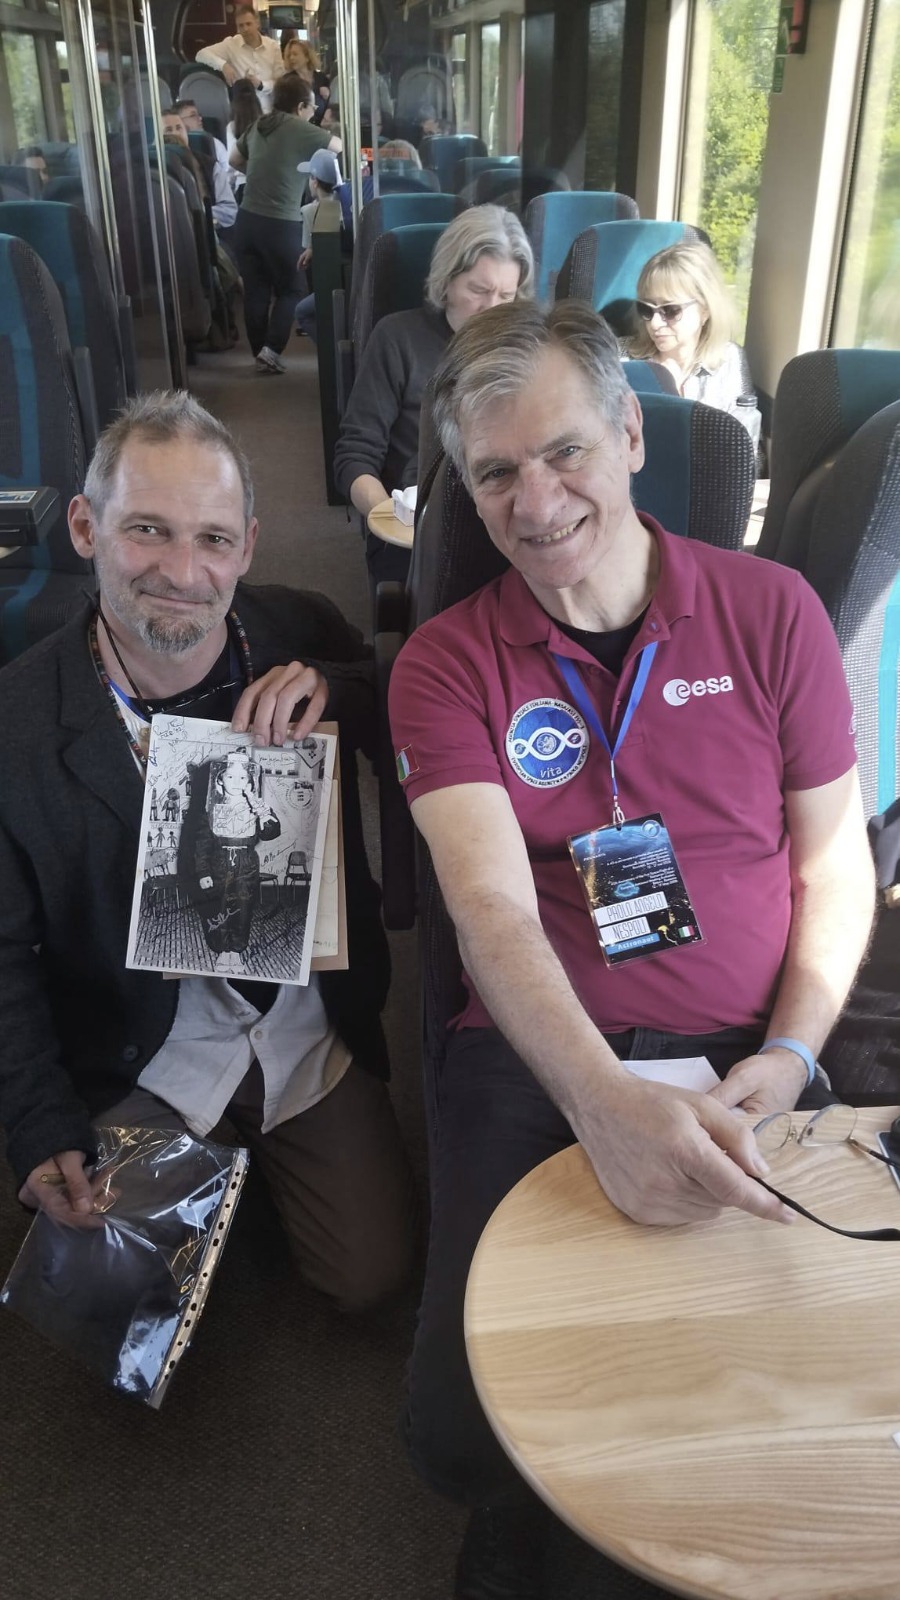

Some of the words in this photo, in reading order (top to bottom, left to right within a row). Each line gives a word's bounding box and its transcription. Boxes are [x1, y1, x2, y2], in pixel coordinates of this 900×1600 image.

[540, 766, 563, 779] vita
[607, 903, 634, 921] PAOLO
[634, 894, 665, 913] ANGELO
[612, 920, 648, 940] NESPOLI
[617, 936, 655, 950] Astronaut
